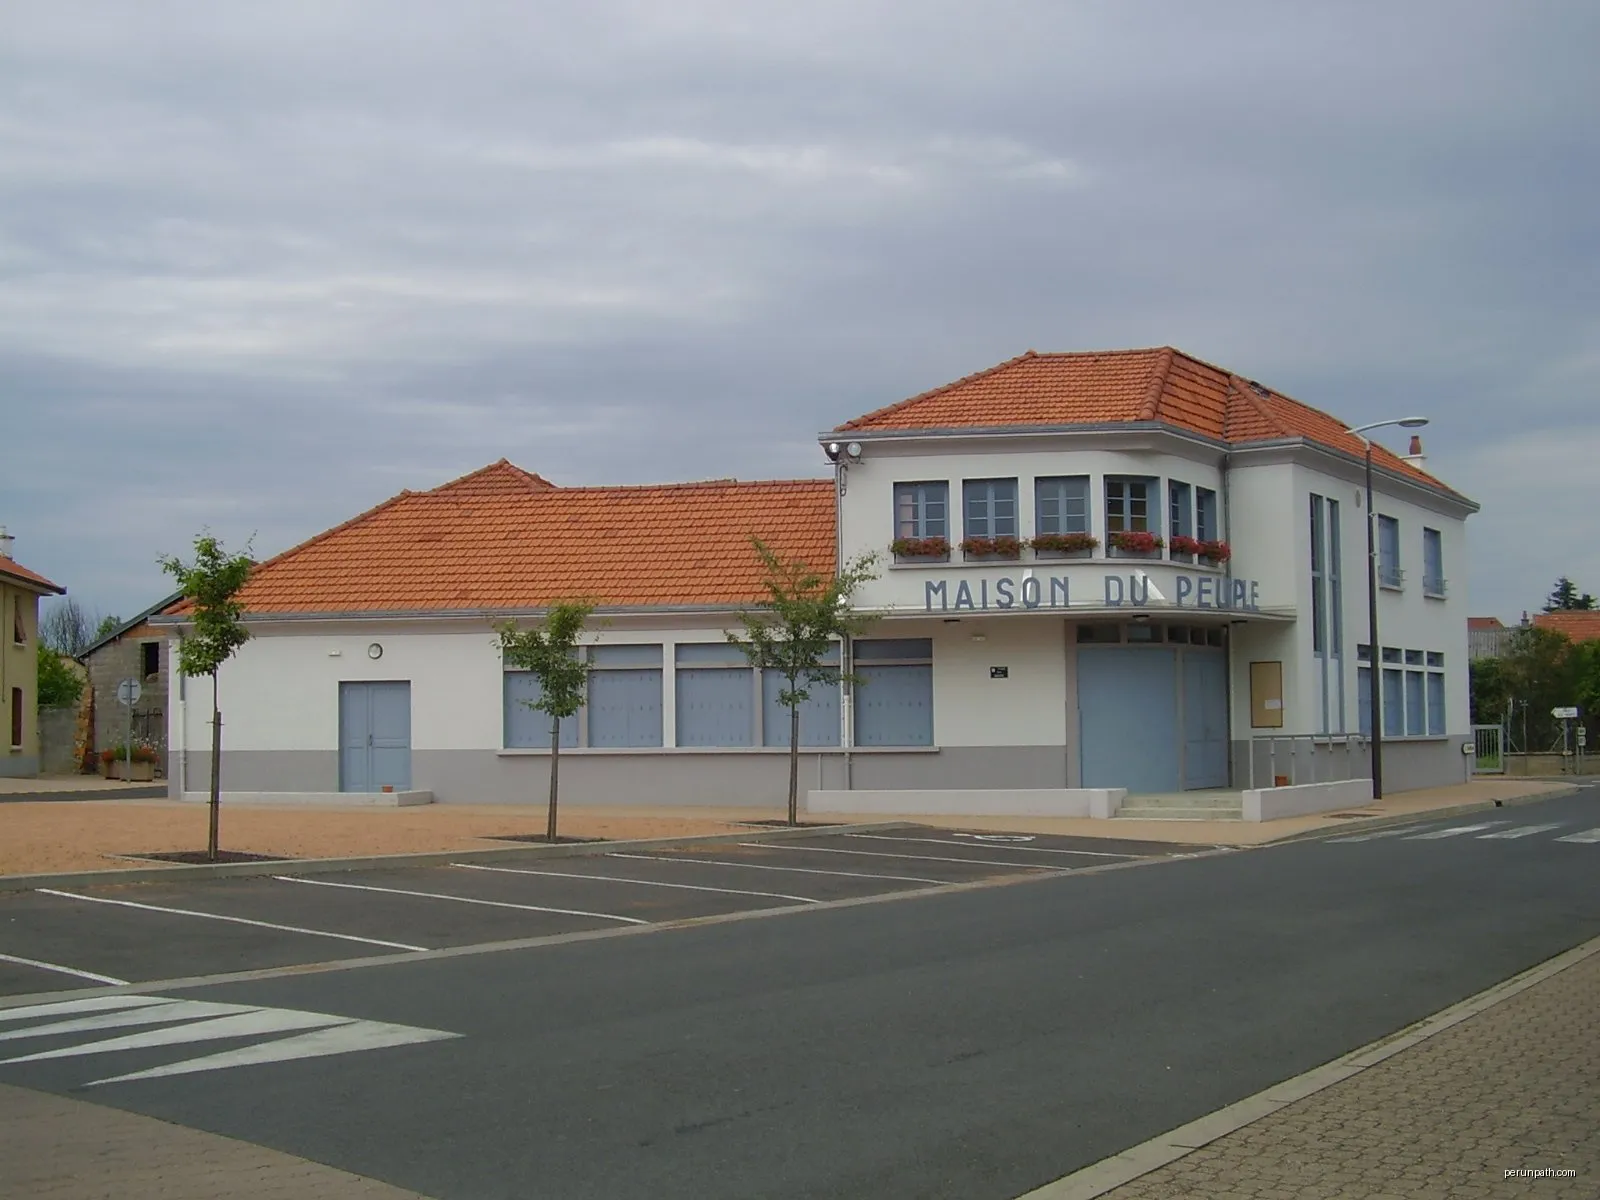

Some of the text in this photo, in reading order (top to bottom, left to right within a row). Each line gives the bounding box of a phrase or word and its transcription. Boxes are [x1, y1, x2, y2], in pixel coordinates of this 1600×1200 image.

[925, 575, 1260, 612] MAISON DU PEUPLE
